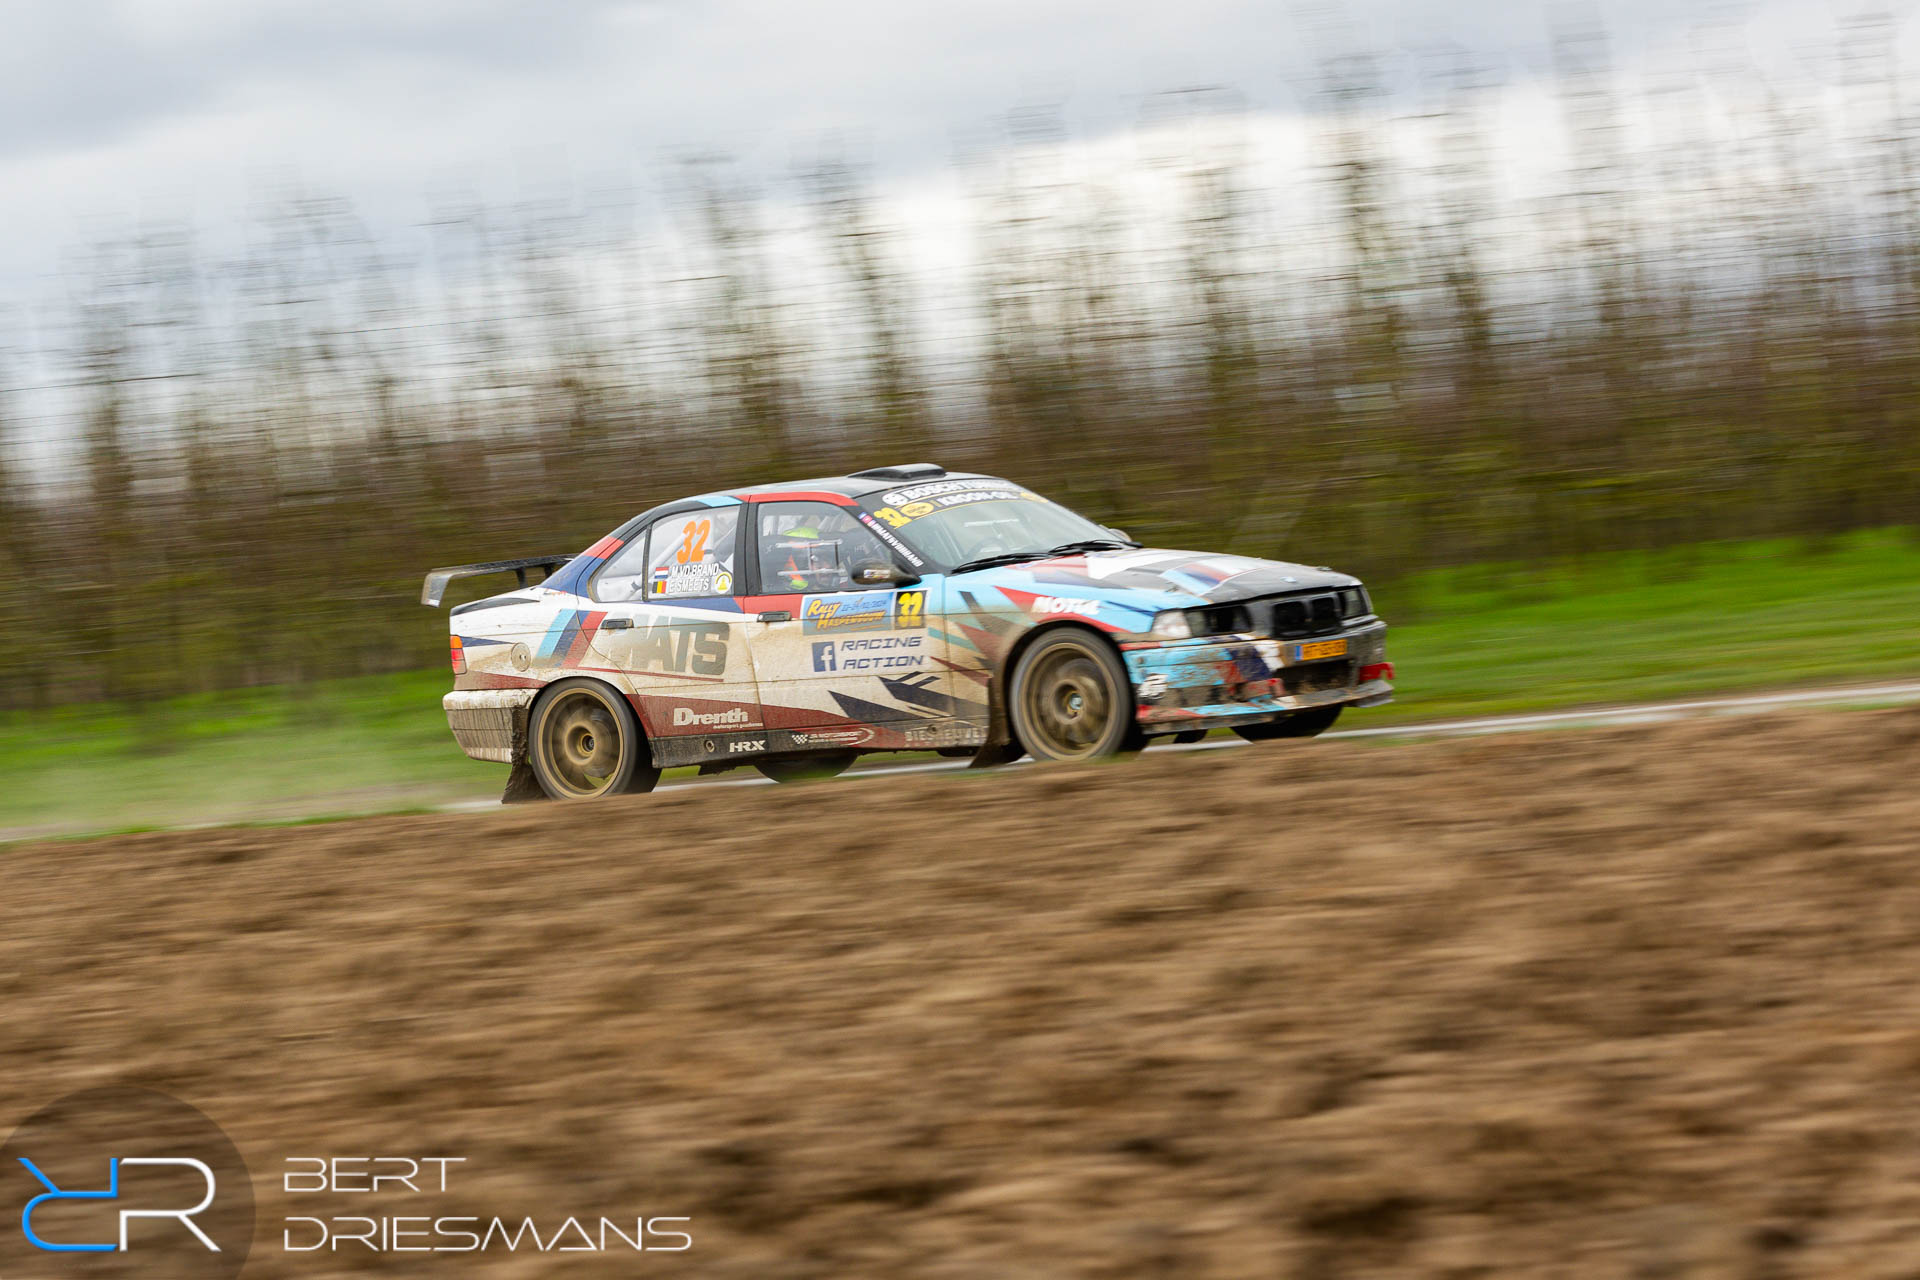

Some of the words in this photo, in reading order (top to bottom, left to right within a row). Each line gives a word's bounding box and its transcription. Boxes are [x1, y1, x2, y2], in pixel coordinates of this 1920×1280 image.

[676, 519, 711, 565] 32
[897, 591, 924, 628] 32
[841, 636, 923, 651] RACING
[843, 655, 924, 670] ACTION
[673, 707, 749, 726] Drenth
[729, 740, 766, 753] HRX
